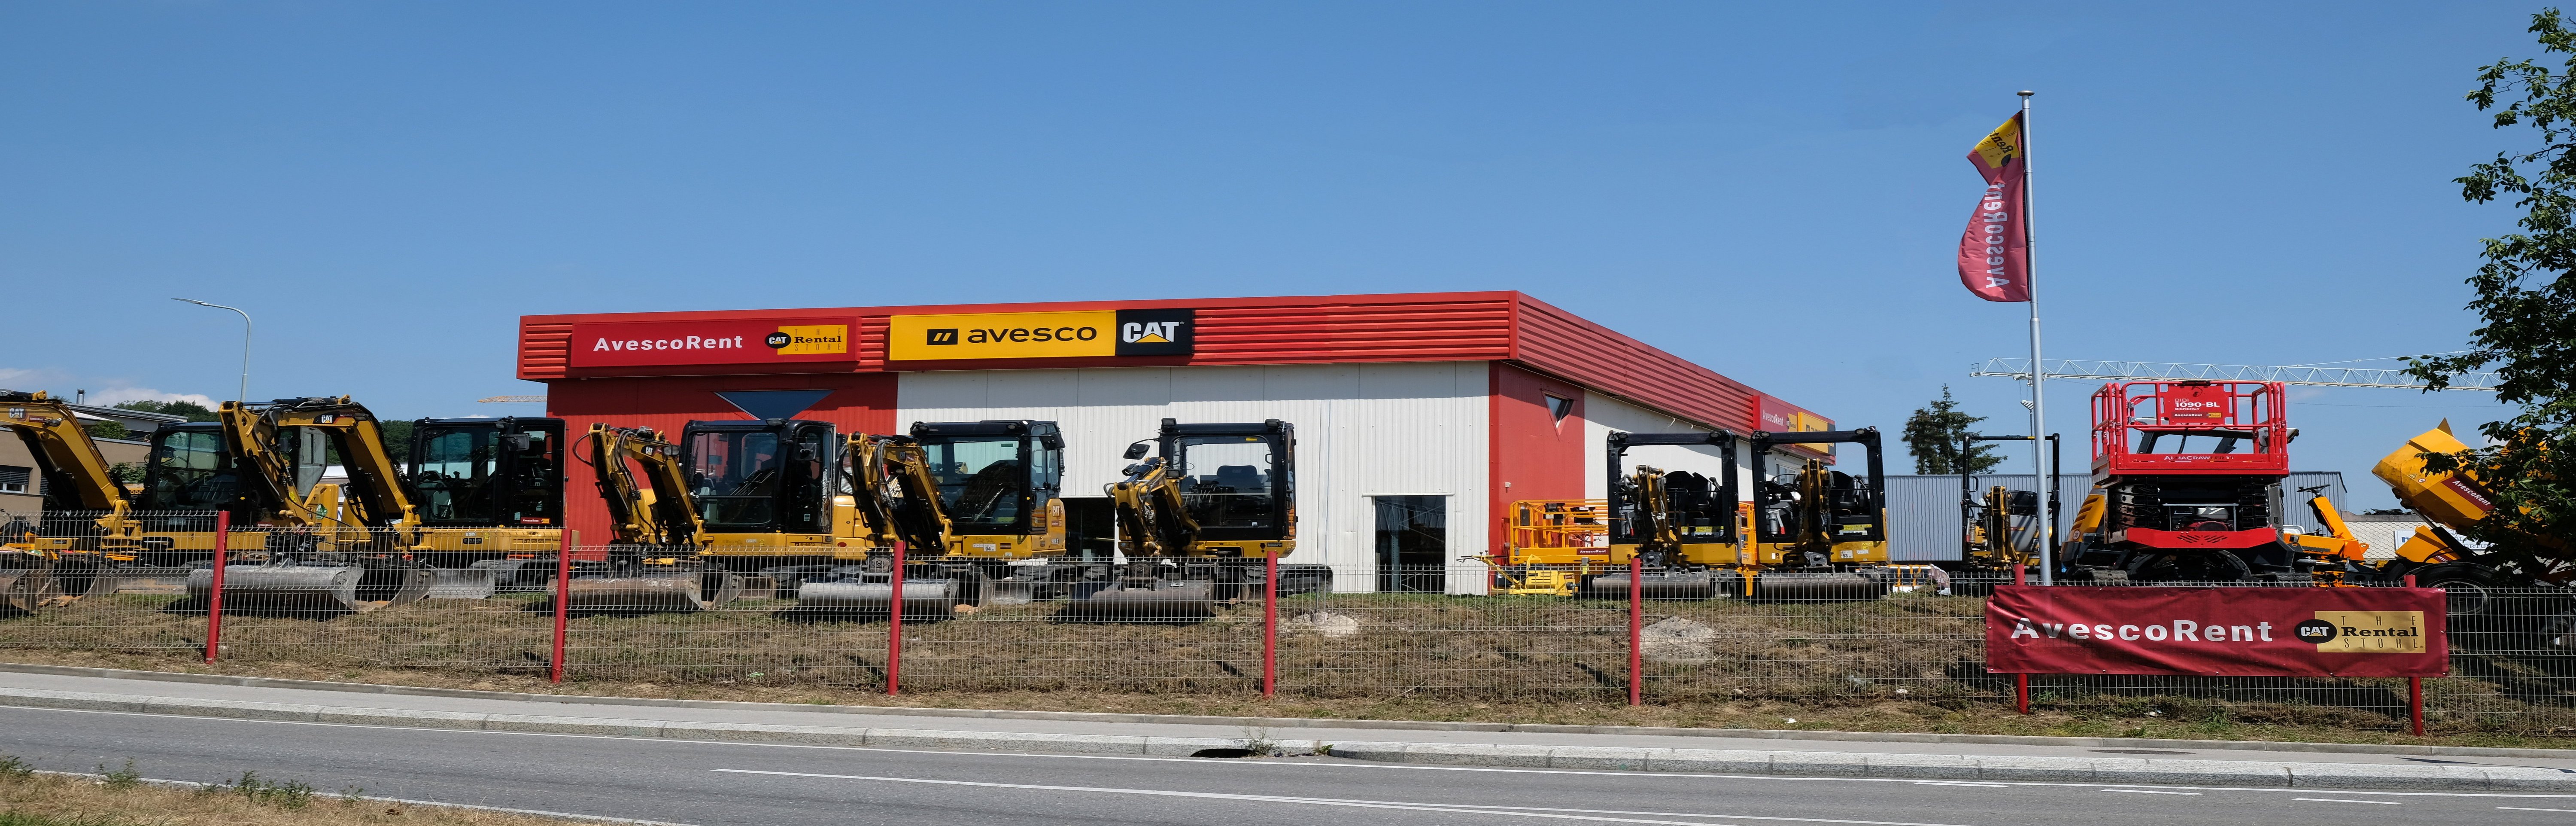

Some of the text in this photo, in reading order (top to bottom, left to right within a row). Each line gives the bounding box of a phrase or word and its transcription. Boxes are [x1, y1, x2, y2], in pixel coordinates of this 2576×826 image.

[967, 326, 1097, 343] avesco
[1123, 322, 1179, 343] CAT
[593, 335, 743, 351] AvescoRent
[9, 408, 24, 418] CAT
[321, 415, 333, 424] CAT
[2452, 481, 2491, 506] AvescoRent
[2341, 616, 2415, 626] THE
[2011, 618, 2273, 642] AvescoRent
[2301, 627, 2329, 637] CAT
[2341, 627, 2418, 637] Rental
[2345, 638, 2418, 648] STORE
